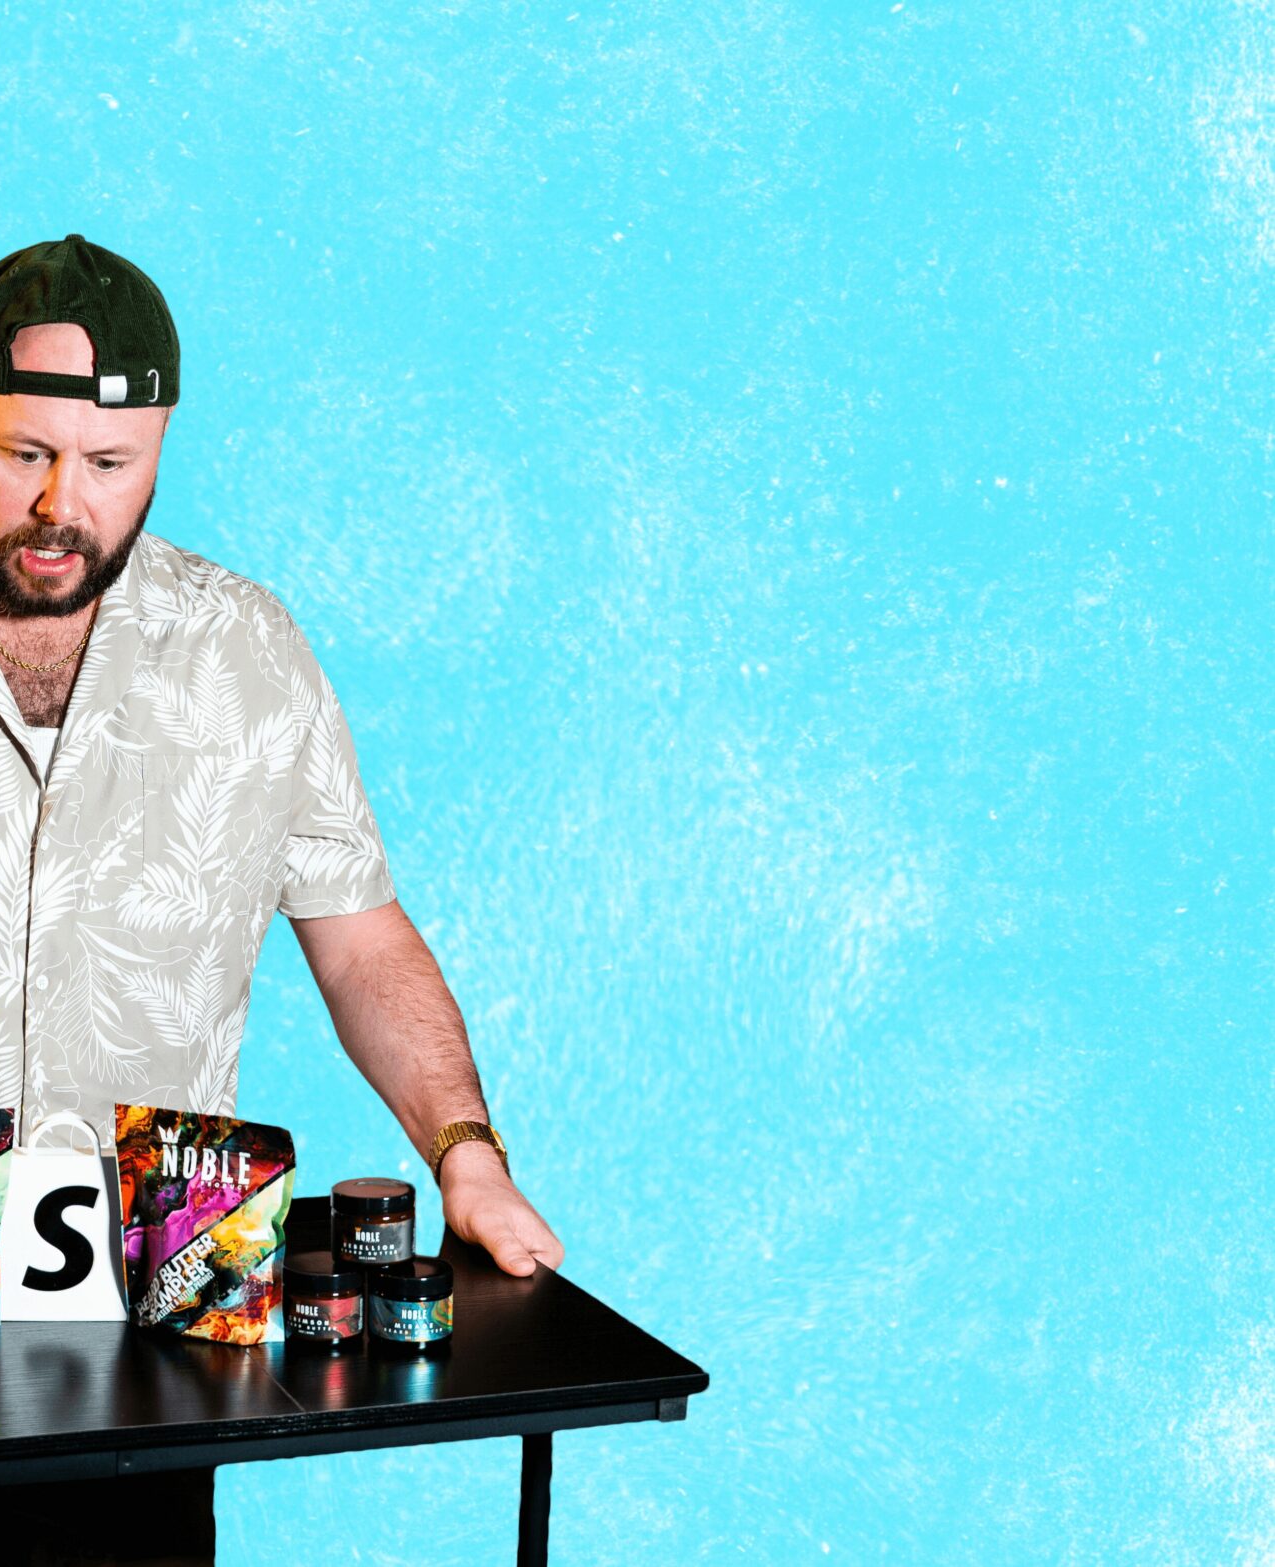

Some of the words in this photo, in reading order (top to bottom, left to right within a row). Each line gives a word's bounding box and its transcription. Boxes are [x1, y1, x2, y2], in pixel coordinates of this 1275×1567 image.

[162, 1144, 251, 1185] NOBLE
[21, 1185, 100, 1292] S
[355, 1231, 380, 1242] NOBLE
[159, 1233, 217, 1284] BUTTER
[296, 1304, 319, 1316] NOBLE
[401, 1309, 427, 1320] NOBLE
